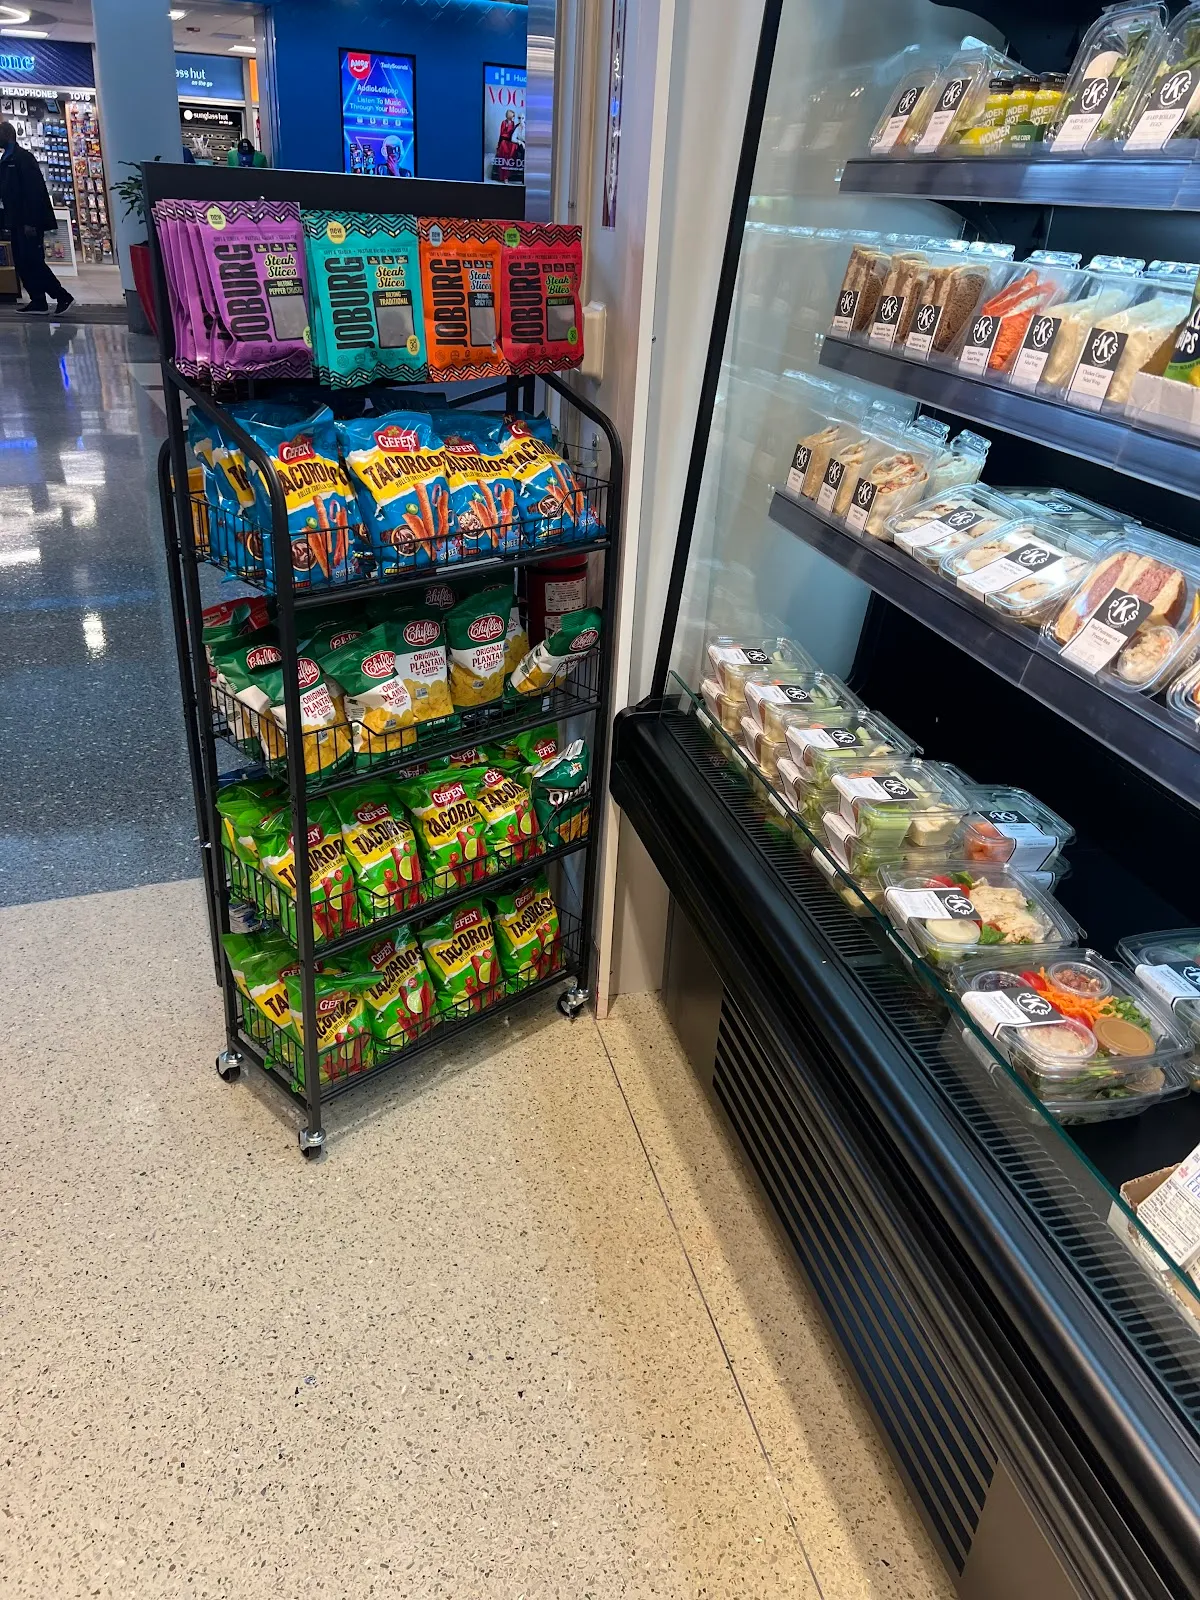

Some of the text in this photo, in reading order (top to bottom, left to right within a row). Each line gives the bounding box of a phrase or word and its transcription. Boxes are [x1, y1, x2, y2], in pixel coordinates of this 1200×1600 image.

[190, 68, 206, 80] hut
[2, 88, 58, 99] HEADPHONES
[943, 82, 962, 104] PKS
[1082, 80, 1109, 107] PKS
[1160, 73, 1191, 103] PKS
[69, 92, 91, 101] TOYS
[350, 103, 374, 111] Through
[375, 105, 388, 113] Your
[1007, 104, 1028, 115] ONDER
[1031, 105, 1054, 117] ONDER
[219, 112, 228, 120] hut
[979, 125, 1010, 144] WONDER
[491, 158, 514, 166] SEEING
[265, 254, 295, 266] Steak
[268, 266, 296, 278] Slices
[376, 266, 404, 277] Steak
[469, 270, 490, 280] Steak
[378, 277, 405, 288] Slices
[471, 280, 491, 290] Slices
[546, 275, 569, 285] Steak
[214, 244, 273, 343] JOBURG
[548, 285, 569, 294] Bites
[325, 257, 375, 350] JOBURG
[430, 259, 468, 347] JOBURG
[508, 262, 543, 345] JOBURG
[841, 293, 854, 311] PKS
[881, 300, 898, 316] PKS
[918, 309, 935, 326] PKS
[973, 320, 993, 338] PKS
[1033, 323, 1054, 342] PKS
[1092, 336, 1118, 358] PKS
[377, 434, 416, 448] GEFEN
[797, 451, 808, 464] PKS
[829, 465, 840, 479] PKS
[858, 485, 873, 500] PKS
[950, 512, 975, 525] PKS
[440, 548, 460, 561] SEET
[1021, 549, 1049, 565] PKS
[335, 565, 357, 578] SWET
[1109, 597, 1139, 624] PKS
[404, 620, 440, 642] Chifles
[470, 618, 504, 638] Chifles
[413, 650, 441, 661] ORIGINAL
[472, 652, 503, 667] PLANTAI
[410, 657, 446, 673] PLANTAIN
[422, 666, 439, 674] CHIPS
[483, 660, 498, 669] CHIPS
[298, 660, 318, 684] ifles
[382, 679, 399, 692] ORIGI
[317, 705, 331, 716] CHIPS
[433, 786, 464, 802] GEFEN
[357, 804, 389, 822] GEFEN
[948, 894, 971, 915] PKS
[436, 922, 494, 966] TACOROO
[371, 943, 394, 965] GEFEN
[320, 998, 341, 1011] GEF
[1020, 992, 1049, 1015] PKS
